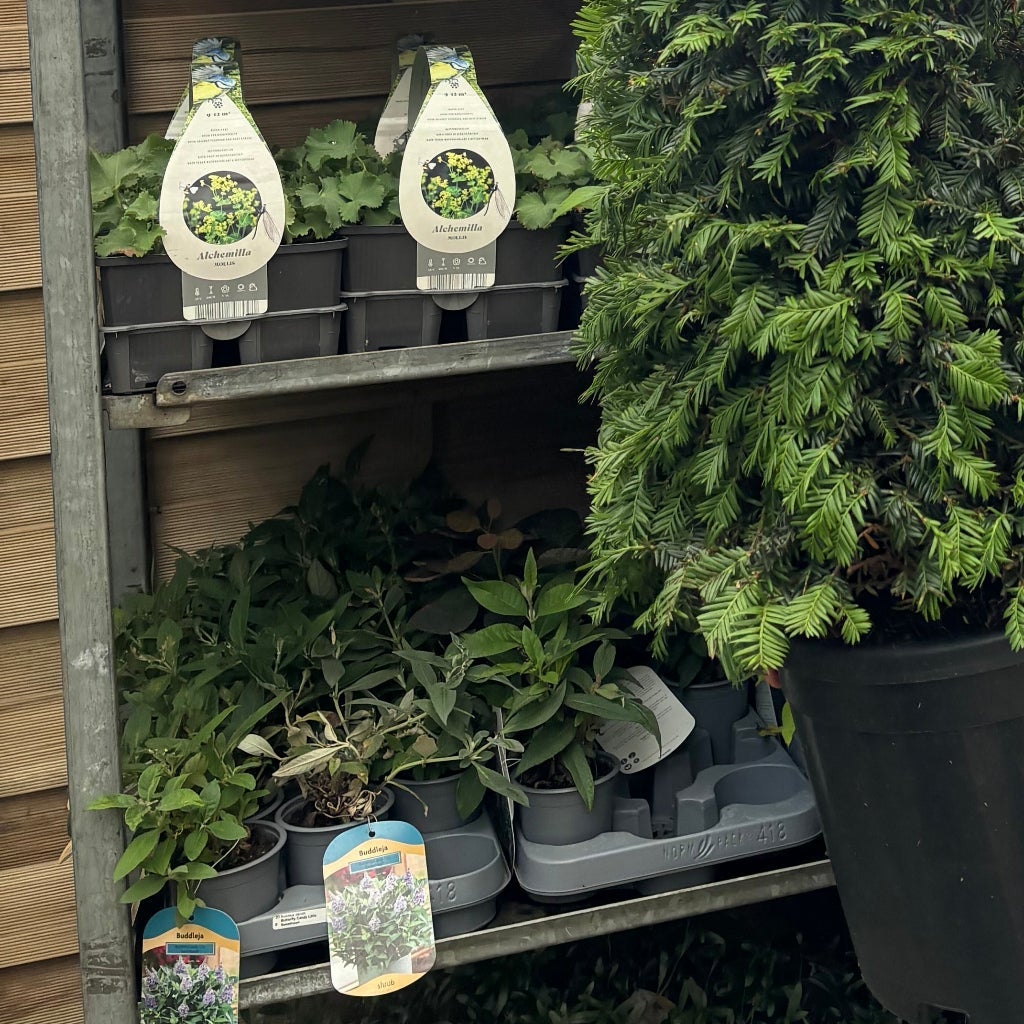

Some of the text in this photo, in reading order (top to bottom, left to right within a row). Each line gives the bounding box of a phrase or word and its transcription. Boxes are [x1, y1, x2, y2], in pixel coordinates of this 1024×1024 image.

[432, 223, 483, 234] Alchemilla
[196, 248, 252, 261] Alchemilla
[757, 821, 788, 846] 418
[358, 845, 389, 857] Buddleja
[176, 932, 204, 941] Buddleja
[377, 979, 395, 990] shrub
